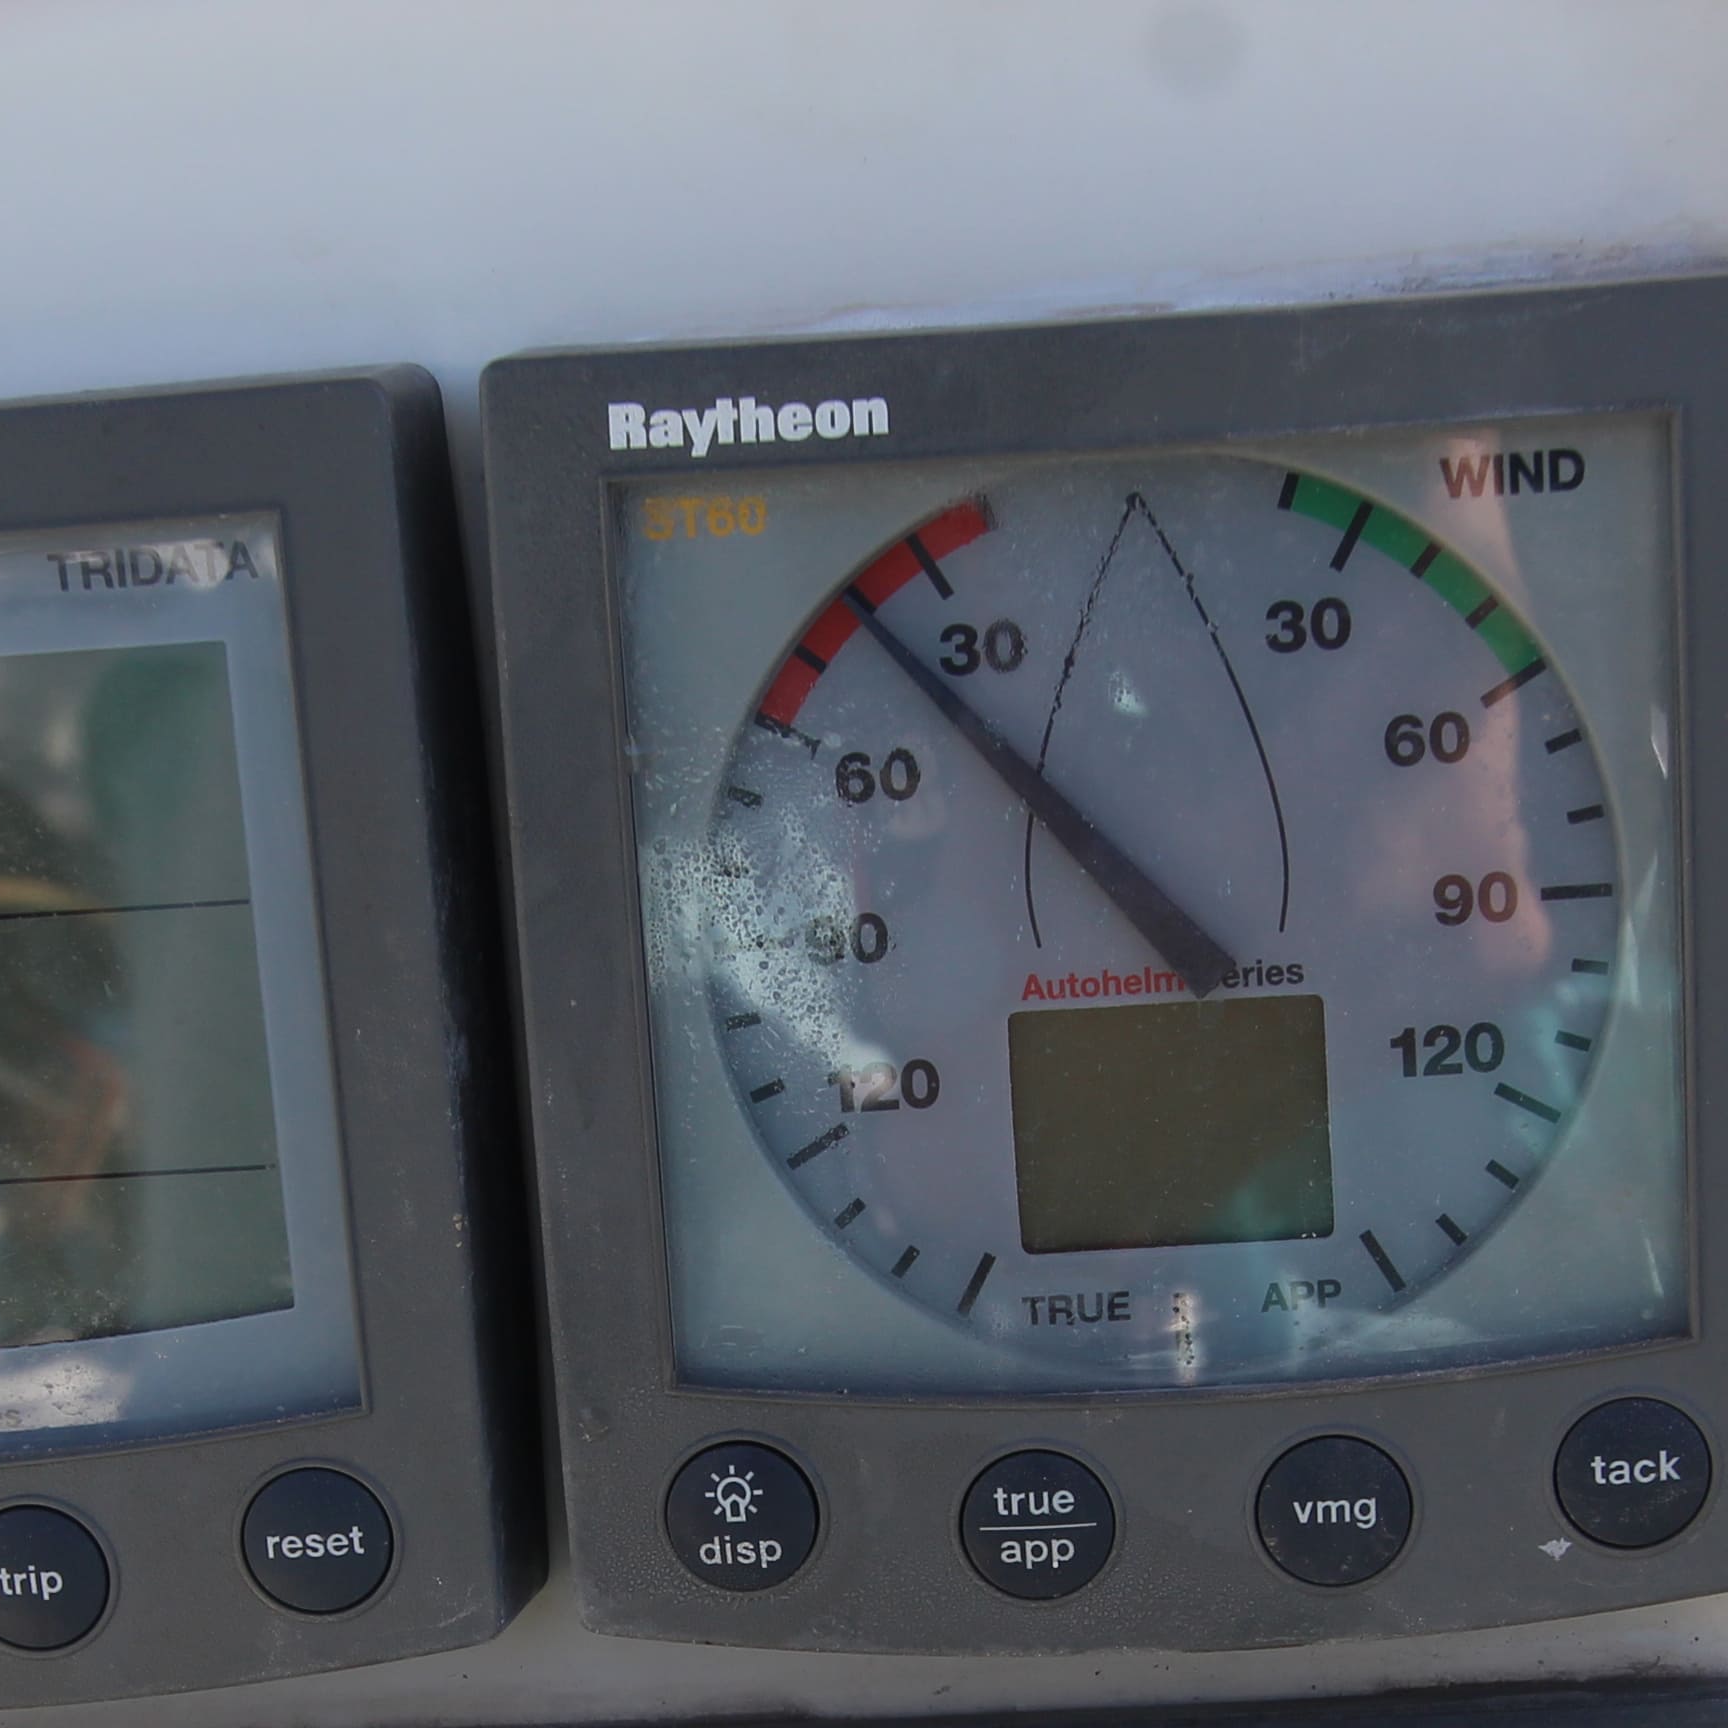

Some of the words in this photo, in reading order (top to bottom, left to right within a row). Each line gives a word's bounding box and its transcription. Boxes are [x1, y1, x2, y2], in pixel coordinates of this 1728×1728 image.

[606, 396, 890, 457] Raytheon
[1439, 448, 1587, 499] WIND
[640, 494, 769, 542] ST60
[46, 539, 260, 593] TRIDATA
[938, 620, 1028, 675] 30
[1264, 596, 1354, 655] 30
[1382, 711, 1472, 769] 60
[834, 748, 922, 805] 60
[1432, 870, 1519, 927] 90
[1220, 958, 1305, 990] eries
[1388, 1021, 1507, 1079] 120
[827, 1057, 941, 1114] 120
[1022, 1289, 1132, 1328] TRUE
[1259, 1277, 1344, 1315] APP
[1589, 1448, 1681, 1487] tack
[992, 1481, 1077, 1518] true
[1291, 1492, 1379, 1532] vmg
[264, 1524, 365, 1561] reset
[698, 1532, 784, 1573] disp
[999, 1534, 1077, 1569] app
